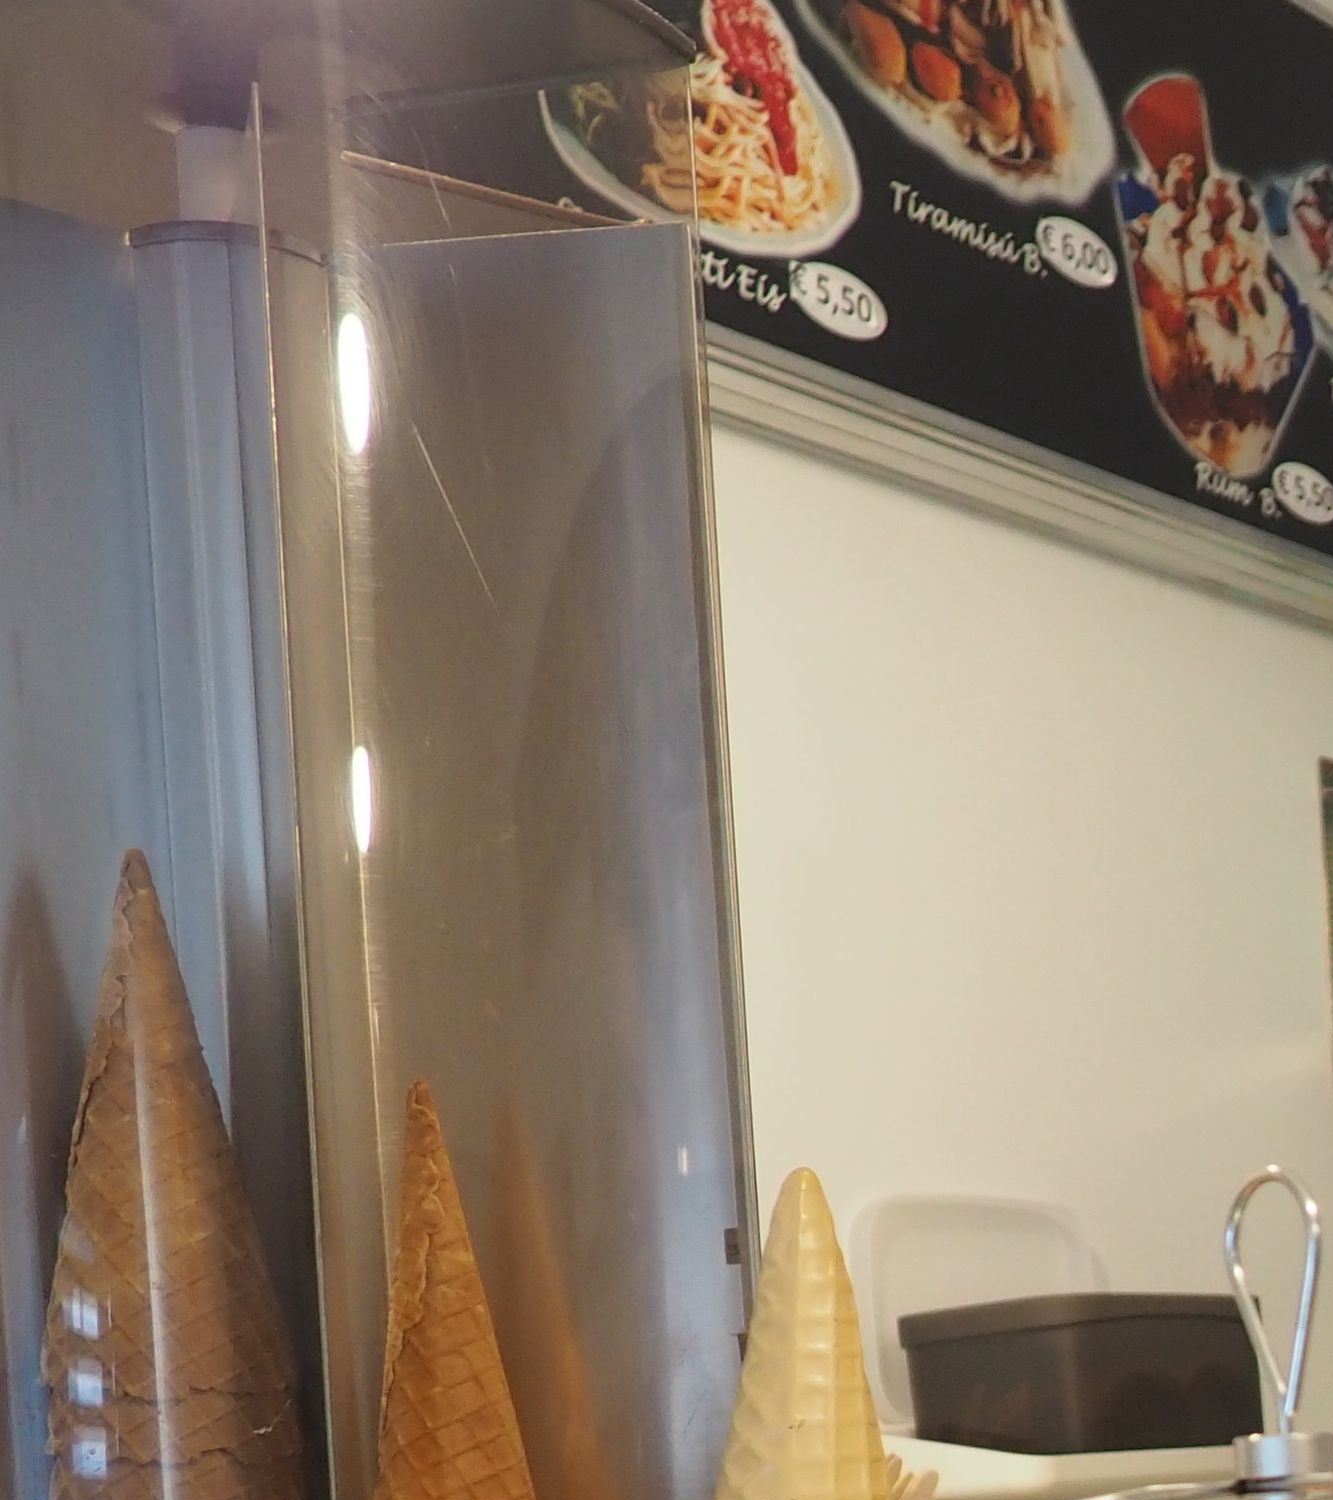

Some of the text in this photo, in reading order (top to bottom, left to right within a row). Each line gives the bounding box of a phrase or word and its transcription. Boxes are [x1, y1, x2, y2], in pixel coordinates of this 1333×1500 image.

[1022, 242, 1049, 279] B.
[1061, 232, 1110, 276] 6,00
[738, 264, 788, 312] Eis
[816, 272, 873, 324] 5,50
[1259, 487, 1283, 518] B.
